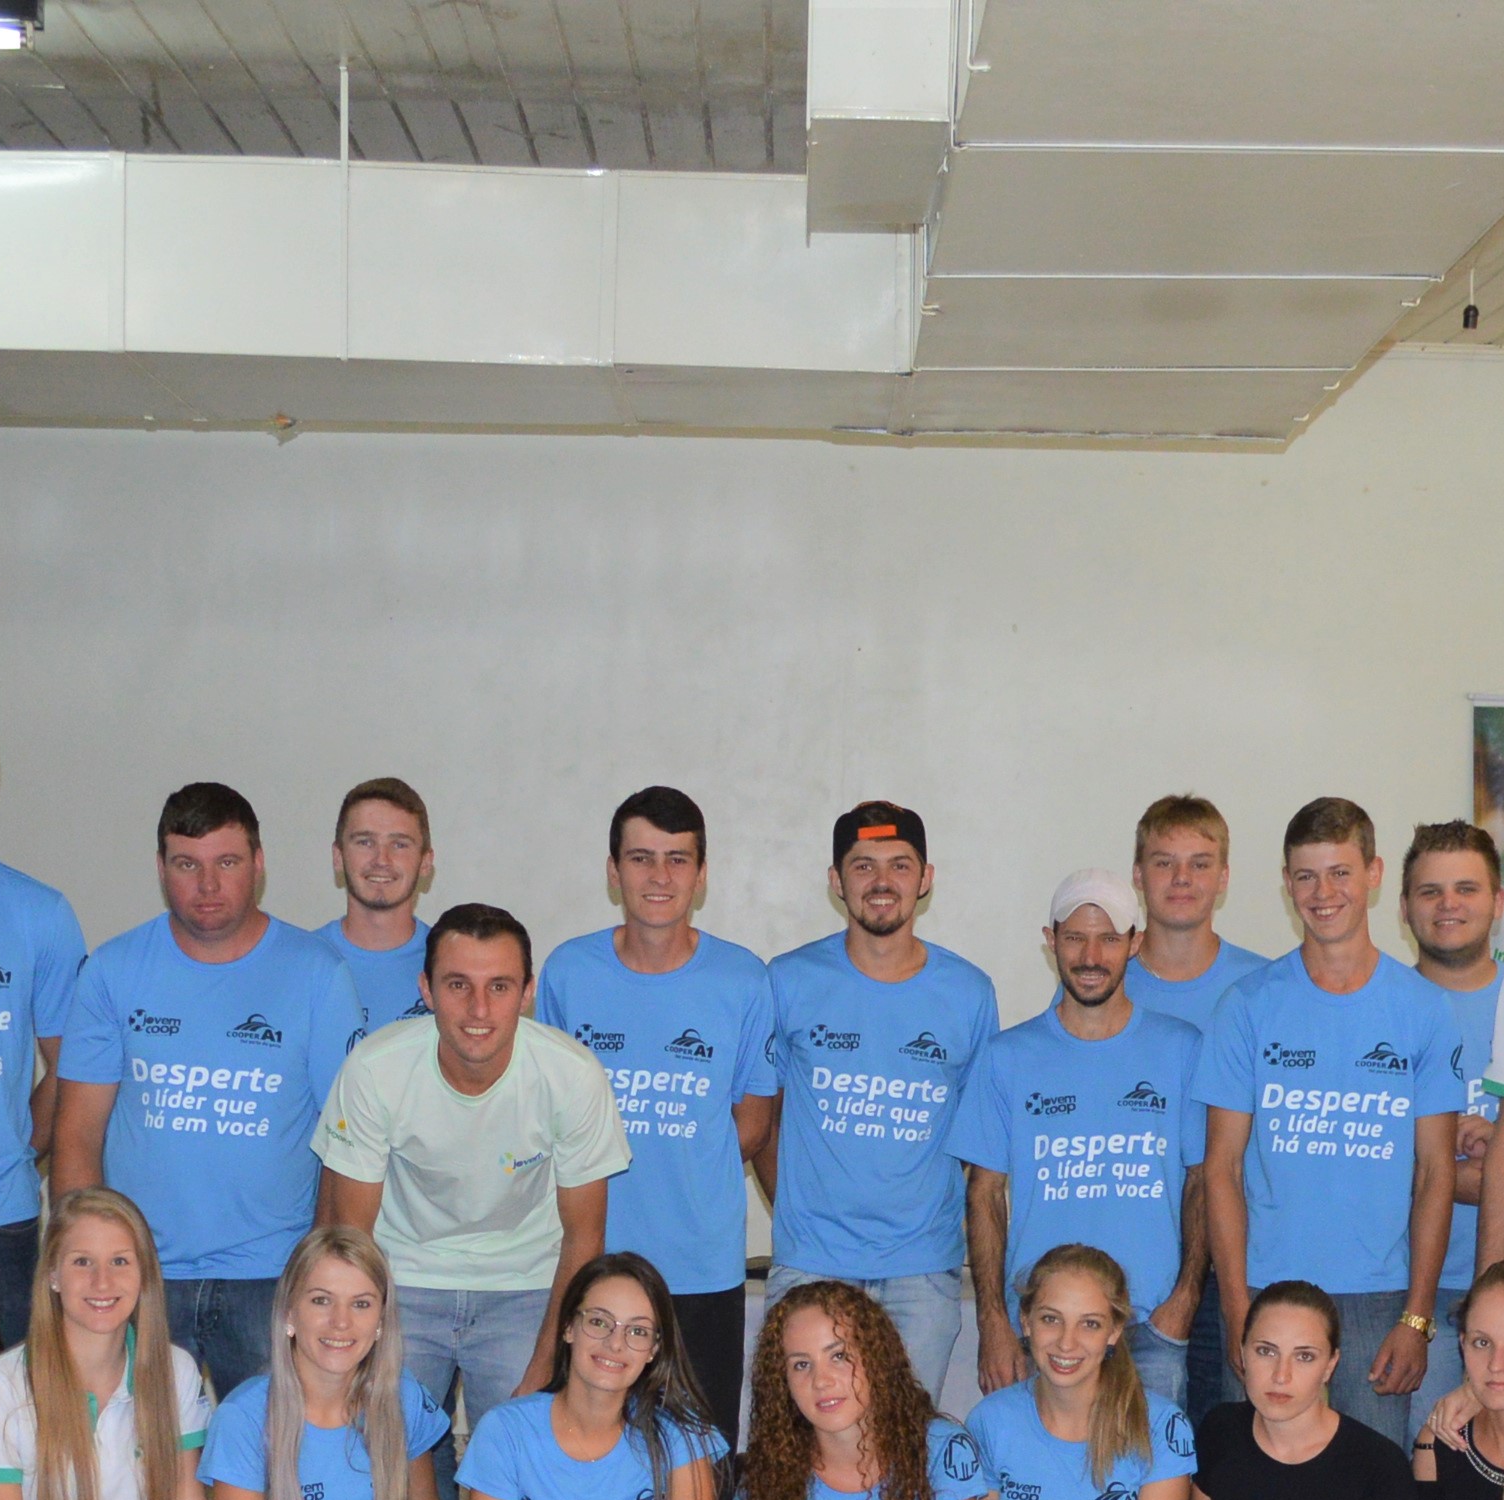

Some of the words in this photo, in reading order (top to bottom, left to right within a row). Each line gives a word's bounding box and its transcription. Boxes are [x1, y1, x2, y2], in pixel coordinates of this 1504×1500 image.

[143, 1016, 181, 1026] jovem
[146, 1025, 179, 1036] coop
[226, 1031, 259, 1040] COOPER
[261, 1029, 282, 1042] A1
[590, 1030, 624, 1041] jovem
[824, 1029, 860, 1041] jovem
[594, 1040, 624, 1052] coop
[665, 1045, 693, 1054] COOPER
[695, 1045, 713, 1058] A1
[828, 1040, 859, 1051] coop
[899, 1048, 929, 1058] COOPER
[930, 1048, 947, 1060] A1
[1279, 1048, 1316, 1060] jovem
[1283, 1058, 1315, 1069] coop
[1388, 1057, 1407, 1070] A1
[132, 1058, 283, 1093] Desperte
[604, 1068, 710, 1096] esperte
[812, 1067, 947, 1102] Desperte
[142, 1092, 149, 1105] o
[155, 1089, 207, 1109] líder
[214, 1098, 257, 1116] que
[616, 1094, 650, 1113] der
[655, 1100, 687, 1118] que
[1041, 1095, 1076, 1109] jovem
[1150, 1096, 1166, 1109] A1
[1261, 1083, 1410, 1117] Desperte
[818, 1099, 829, 1110] o
[836, 1097, 885, 1117] líder
[890, 1107, 929, 1124] que
[1045, 1103, 1076, 1115] coop
[145, 1110, 164, 1130] há
[172, 1116, 207, 1132] em
[217, 1118, 269, 1137] você
[822, 1115, 846, 1133] há
[855, 1123, 885, 1138] em
[1269, 1118, 1280, 1131] o
[1288, 1114, 1337, 1134] líder
[1343, 1121, 1383, 1140] que
[1035, 1131, 1167, 1161] Desperte
[1272, 1135, 1299, 1153] há
[1307, 1141, 1337, 1155] em
[1345, 1141, 1394, 1159] você
[1038, 1167, 1049, 1180] o
[1058, 1160, 1105, 1179] líder
[1112, 1163, 1150, 1180] que
[1044, 1181, 1068, 1201] há
[1076, 1184, 1107, 1198] em
[1115, 1180, 1163, 1198] você
